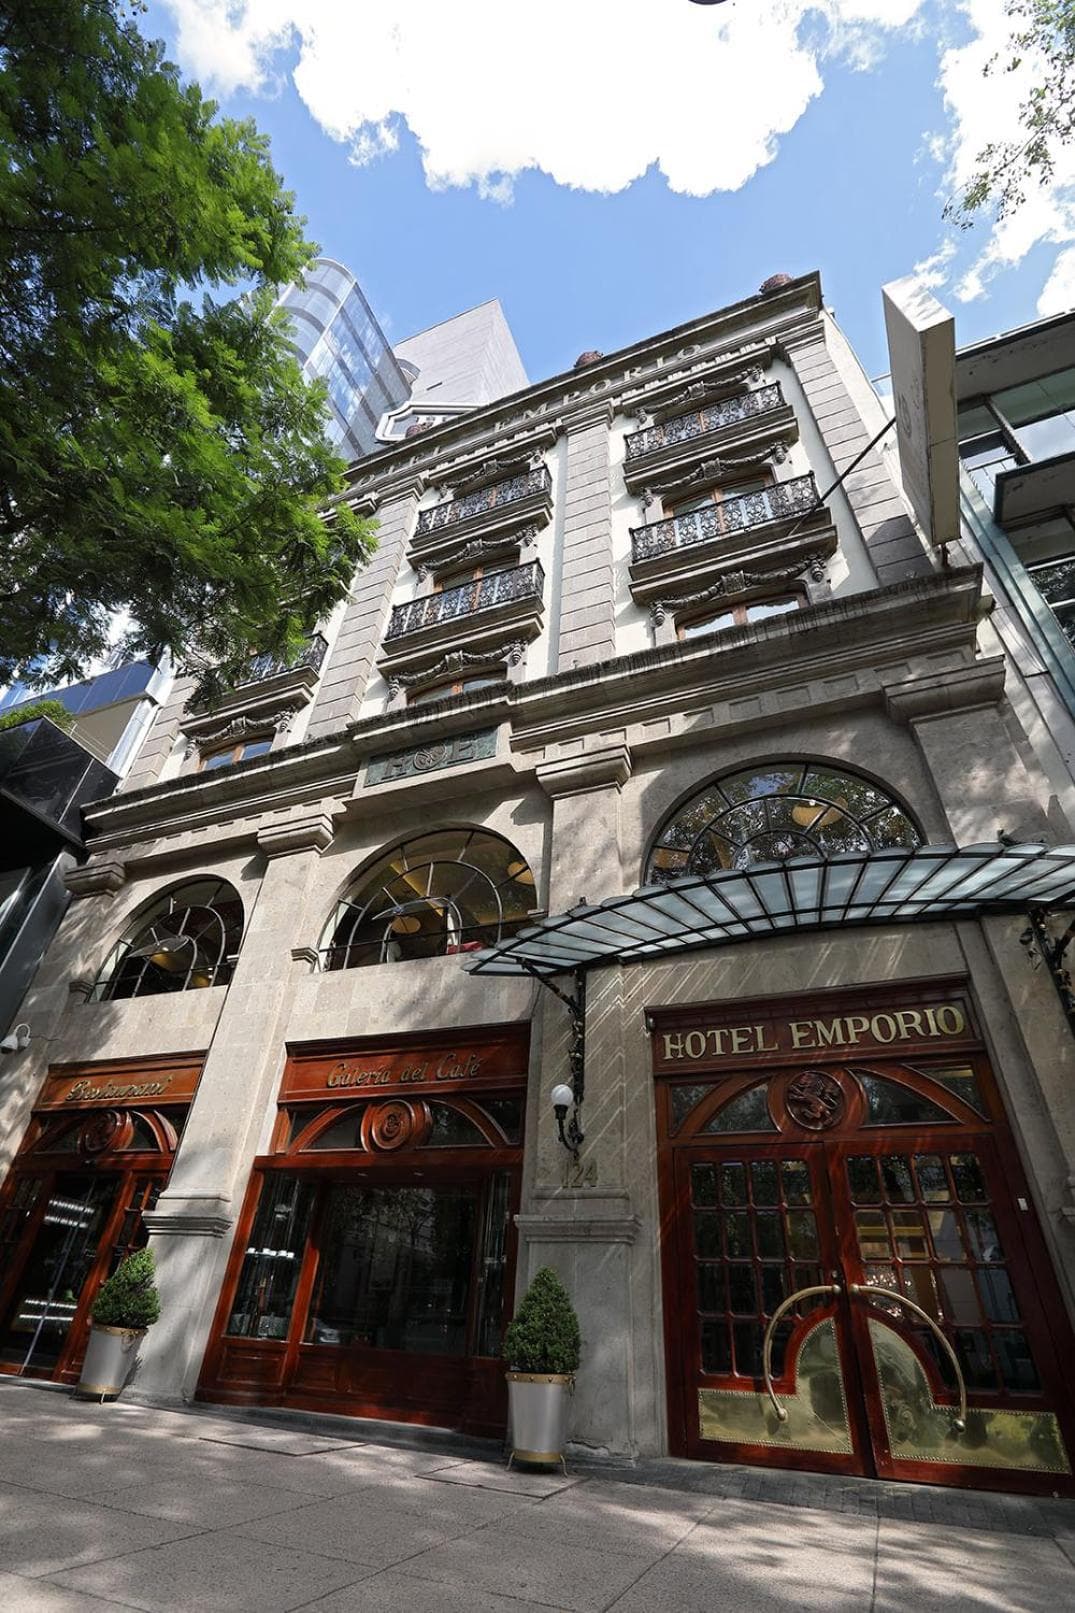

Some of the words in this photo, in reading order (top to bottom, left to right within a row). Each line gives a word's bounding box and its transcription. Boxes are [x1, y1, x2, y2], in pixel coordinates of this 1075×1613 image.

[663, 1025, 778, 1060] HOTEL
[789, 1006, 966, 1050] EMPORIO
[401, 1061, 429, 1083] del
[436, 1053, 487, 1080] Café
